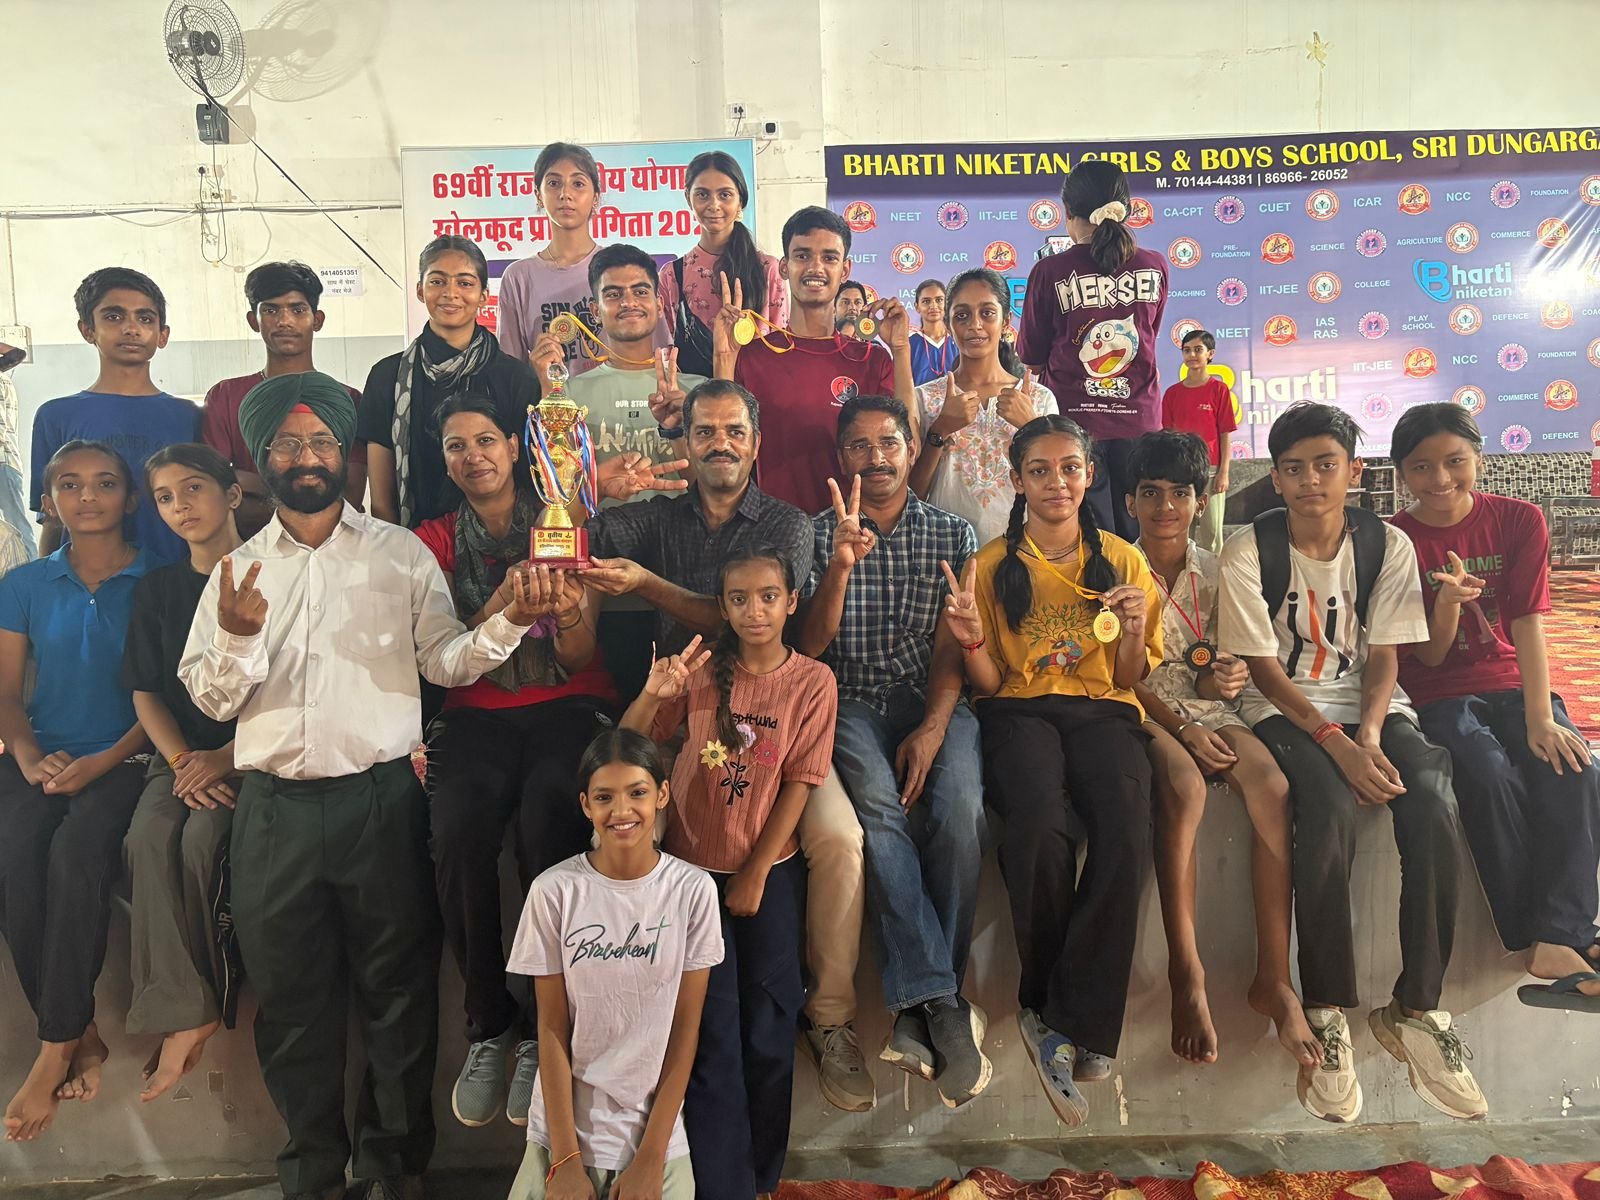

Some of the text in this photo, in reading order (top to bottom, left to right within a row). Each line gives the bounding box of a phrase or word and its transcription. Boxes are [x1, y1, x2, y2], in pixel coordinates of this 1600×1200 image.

[843, 153, 945, 176] BHARTI
[956, 152, 1071, 175] NIKETAN
[1171, 149, 1191, 172] &
[1201, 146, 1273, 171] BOYS
[1283, 139, 1403, 167] SCHOOL,
[1412, 135, 1456, 159] SRI
[1467, 129, 1600, 157] DUNGARG
[432, 164, 494, 199] 69वीं
[1156, 177, 1171, 189] M.
[1175, 174, 1253, 188] 70144-44381
[1311, 167, 1349, 182] 26052
[1446, 191, 1472, 202] NCC
[1530, 188, 1569, 196] FOUNDATION
[1353, 196, 1382, 208] ICAR
[1163, 207, 1204, 218] CA-CPT
[1259, 202, 1292, 213] CUET
[890, 211, 922, 222] NEET
[979, 210, 1018, 221] IIT-JEE
[1491, 230, 1531, 239] COMMERCE
[1396, 236, 1443, 246] AGRICULTURE
[1310, 242, 1345, 251] SCIENCE
[939, 253, 969, 263] ICAR
[1211, 251, 1250, 259] FOUNDATION
[1354, 279, 1391, 288] COLLEGE
[1414, 259, 1513, 301] Bharti
[1168, 289, 1206, 298] COACHING
[1259, 284, 1299, 295] IIT-JEE
[1455, 284, 1513, 299] niketan
[1492, 312, 1529, 321] DEFENCE
[1582, 308, 1600, 316] COAC
[1315, 317, 1335, 326] IAS
[1408, 315, 1429, 323] PLAY
[1402, 322, 1435, 331] SCHOOL
[1216, 327, 1251, 338] NEET
[1313, 329, 1338, 339] RAS
[1538, 350, 1577, 359] FOUNDATION
[1452, 355, 1478, 365] NCC
[1353, 360, 1393, 372] IIT-JEE
[1498, 393, 1539, 402] COMMERCE
[615, 400, 649, 408] OUR STOR
[1542, 431, 1579, 440] DEFENCE
